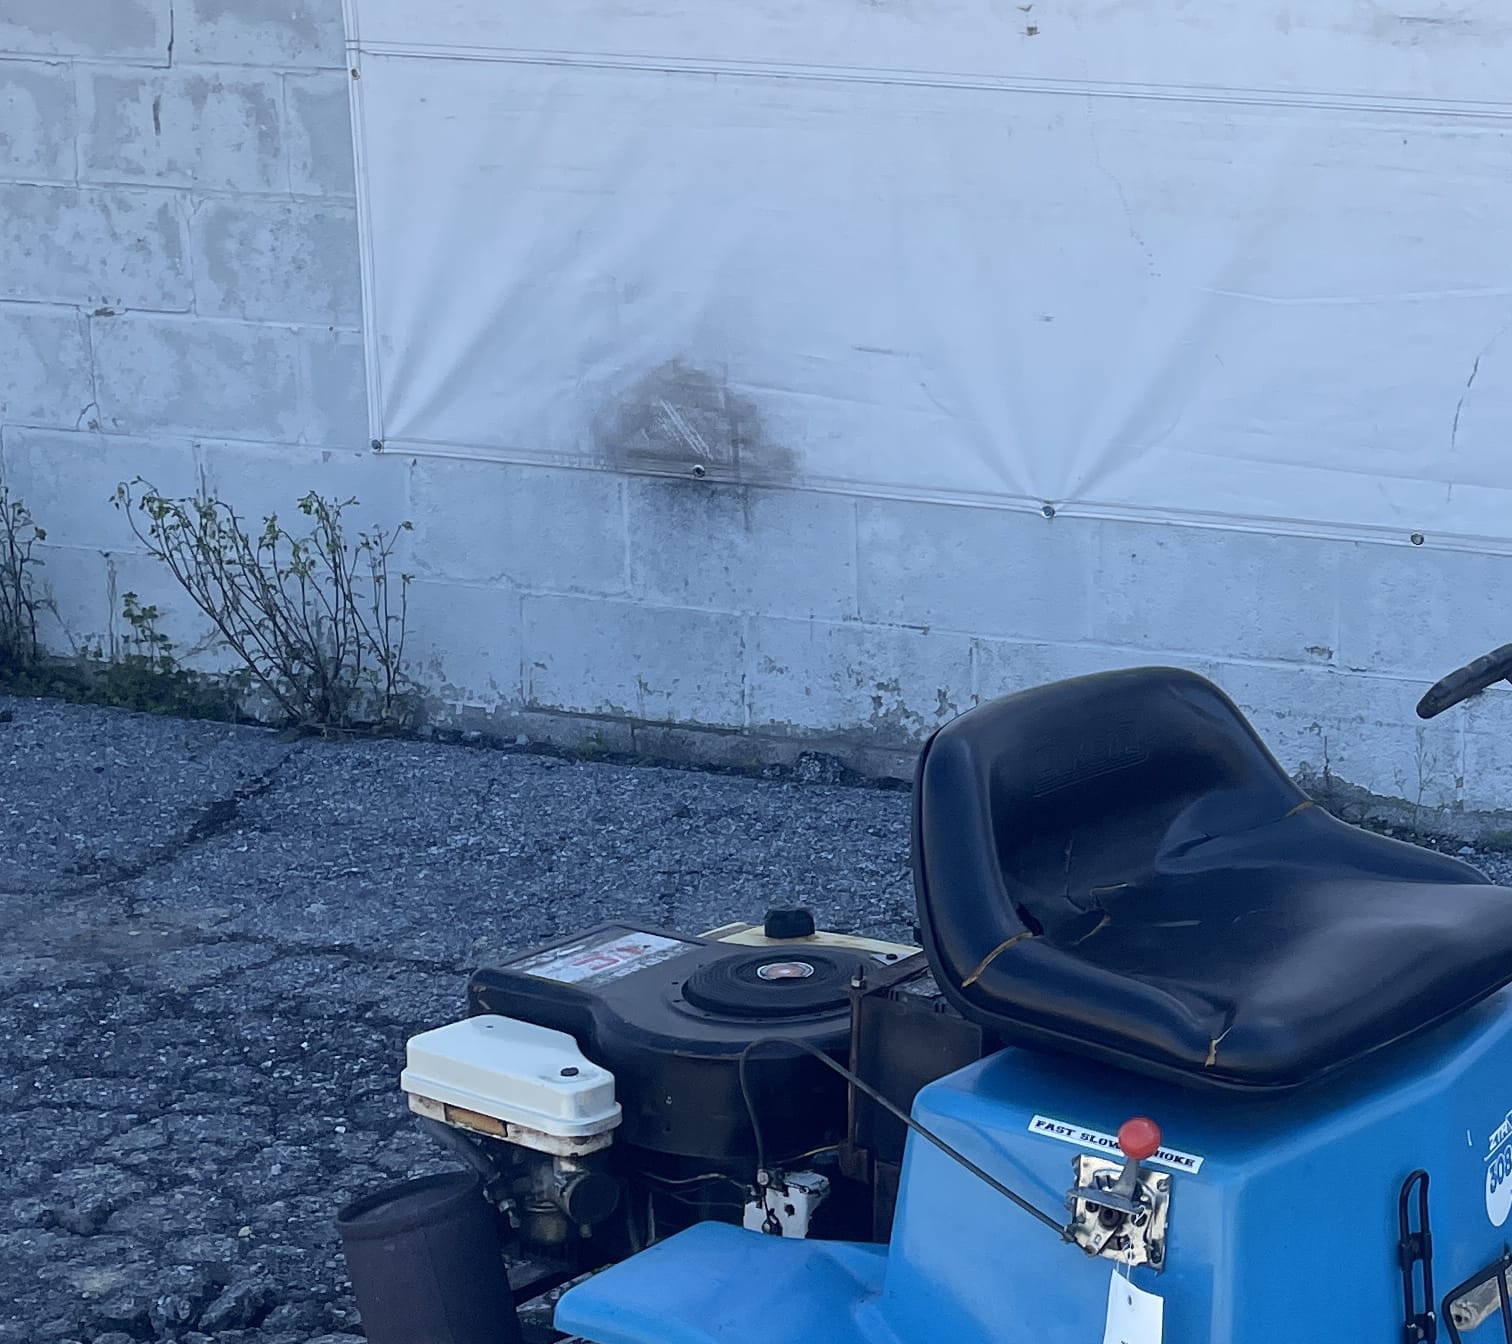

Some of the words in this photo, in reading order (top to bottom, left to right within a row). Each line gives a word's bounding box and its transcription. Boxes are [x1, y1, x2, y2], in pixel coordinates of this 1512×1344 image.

[1034, 1118, 1076, 1138] FAST
[1079, 1131, 1121, 1151] SLOW
[1152, 1149, 1196, 1168] HOKE
